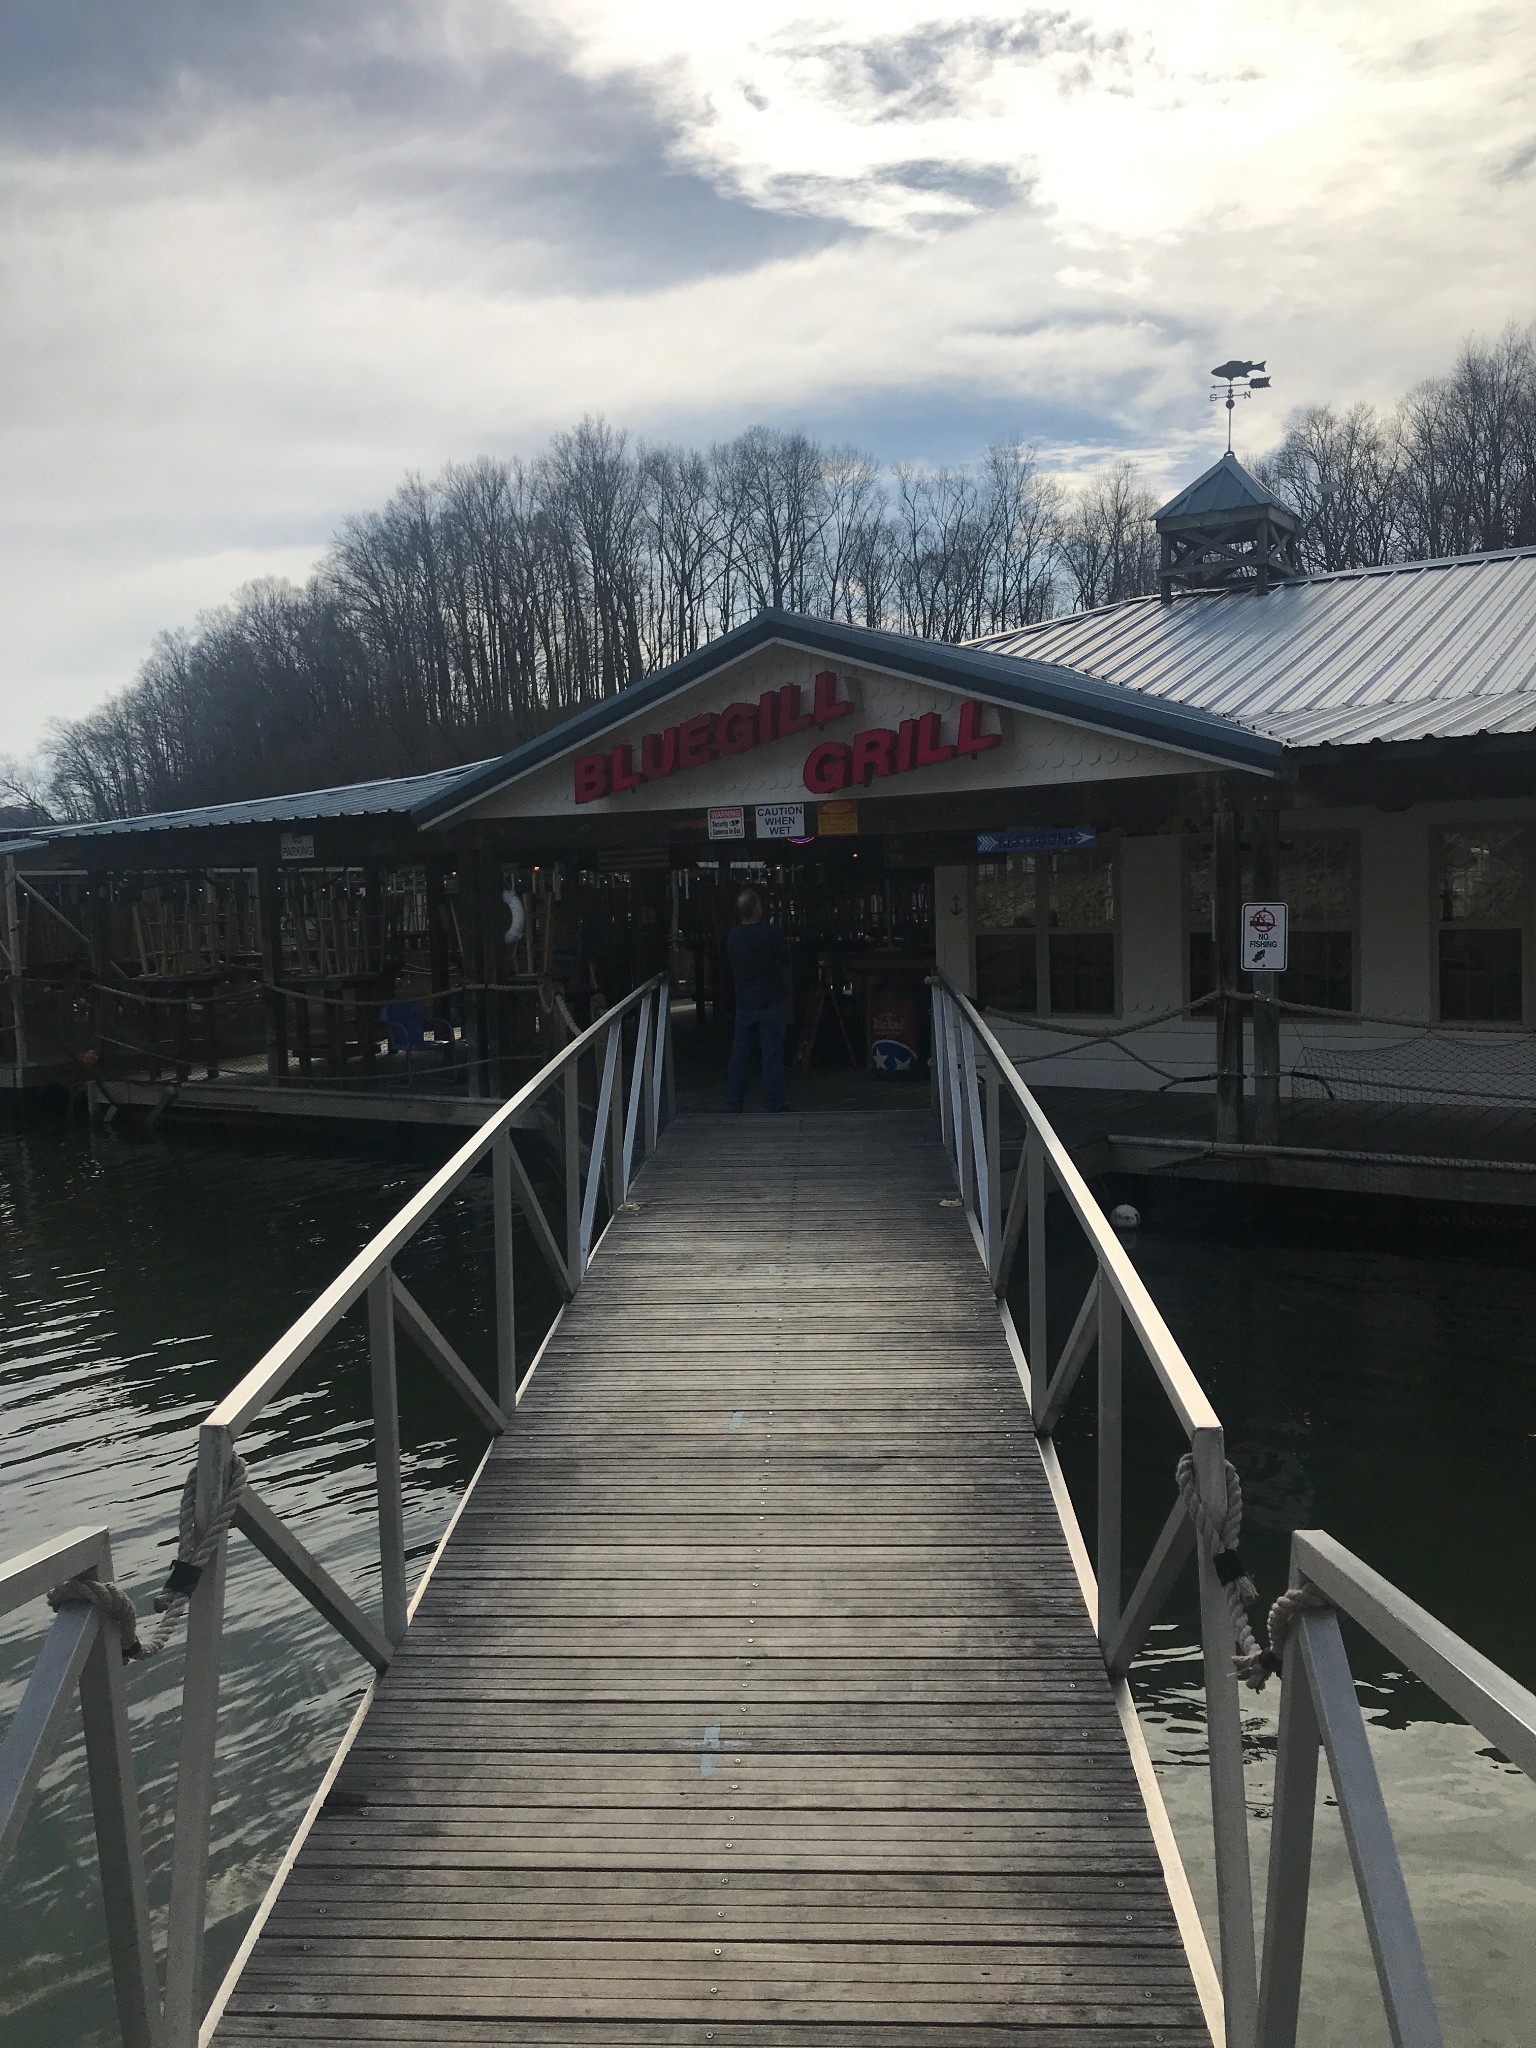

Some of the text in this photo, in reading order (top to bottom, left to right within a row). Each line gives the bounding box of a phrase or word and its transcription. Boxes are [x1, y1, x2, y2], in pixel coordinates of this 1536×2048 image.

[575, 671, 854, 804] BLUEGILL
[803, 700, 1002, 794] GRILL
[711, 809, 741, 819] WARNING
[757, 806, 803, 817] CAUTION
[765, 816, 795, 826] WHEN
[769, 826, 792, 836] WET
[998, 831, 1078, 848] RESTROOMS
[281, 846, 314, 857] PARKING
[1258, 933, 1269, 941] NO
